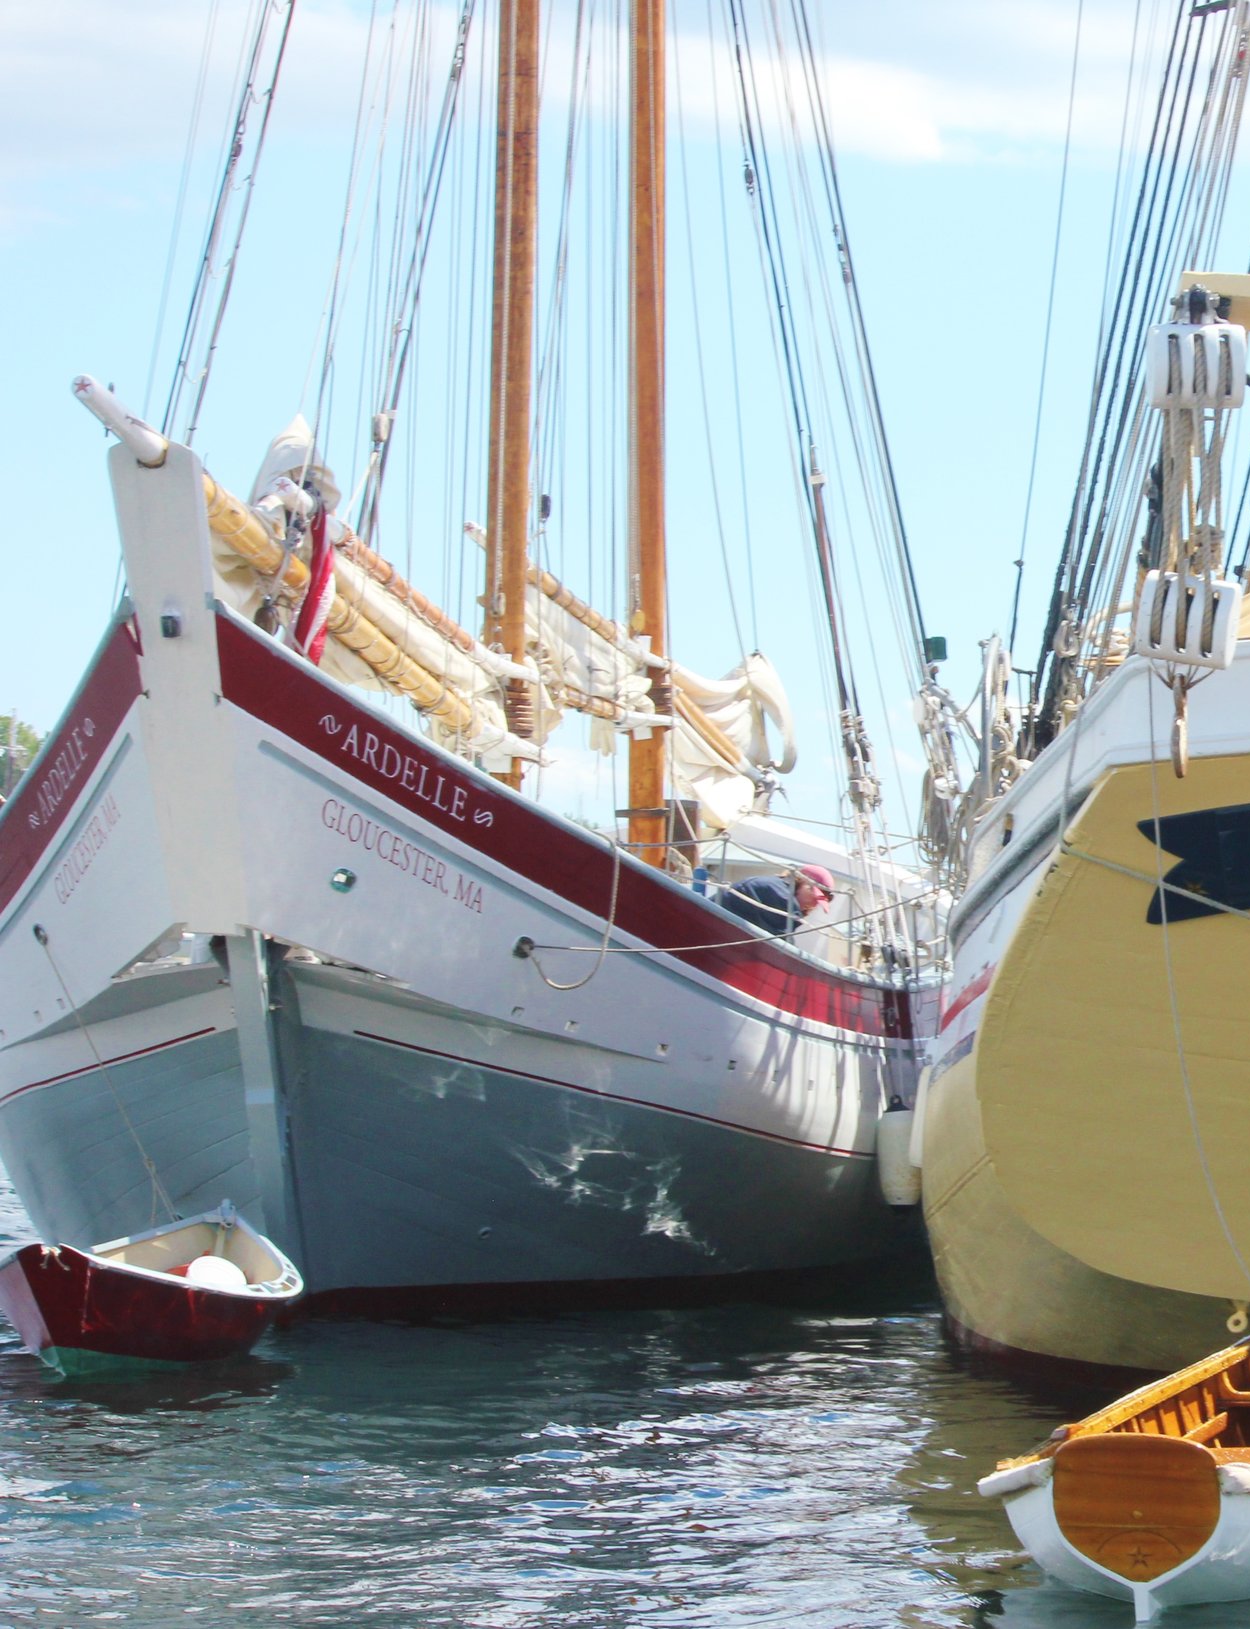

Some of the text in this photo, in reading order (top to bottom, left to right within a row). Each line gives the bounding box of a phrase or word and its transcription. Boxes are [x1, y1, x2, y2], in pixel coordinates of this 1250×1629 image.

[36, 727, 88, 825] ARDELLE
[341, 724, 468, 822] ARDELLE
[322, 798, 483, 914] GLOUCESTER, MA
